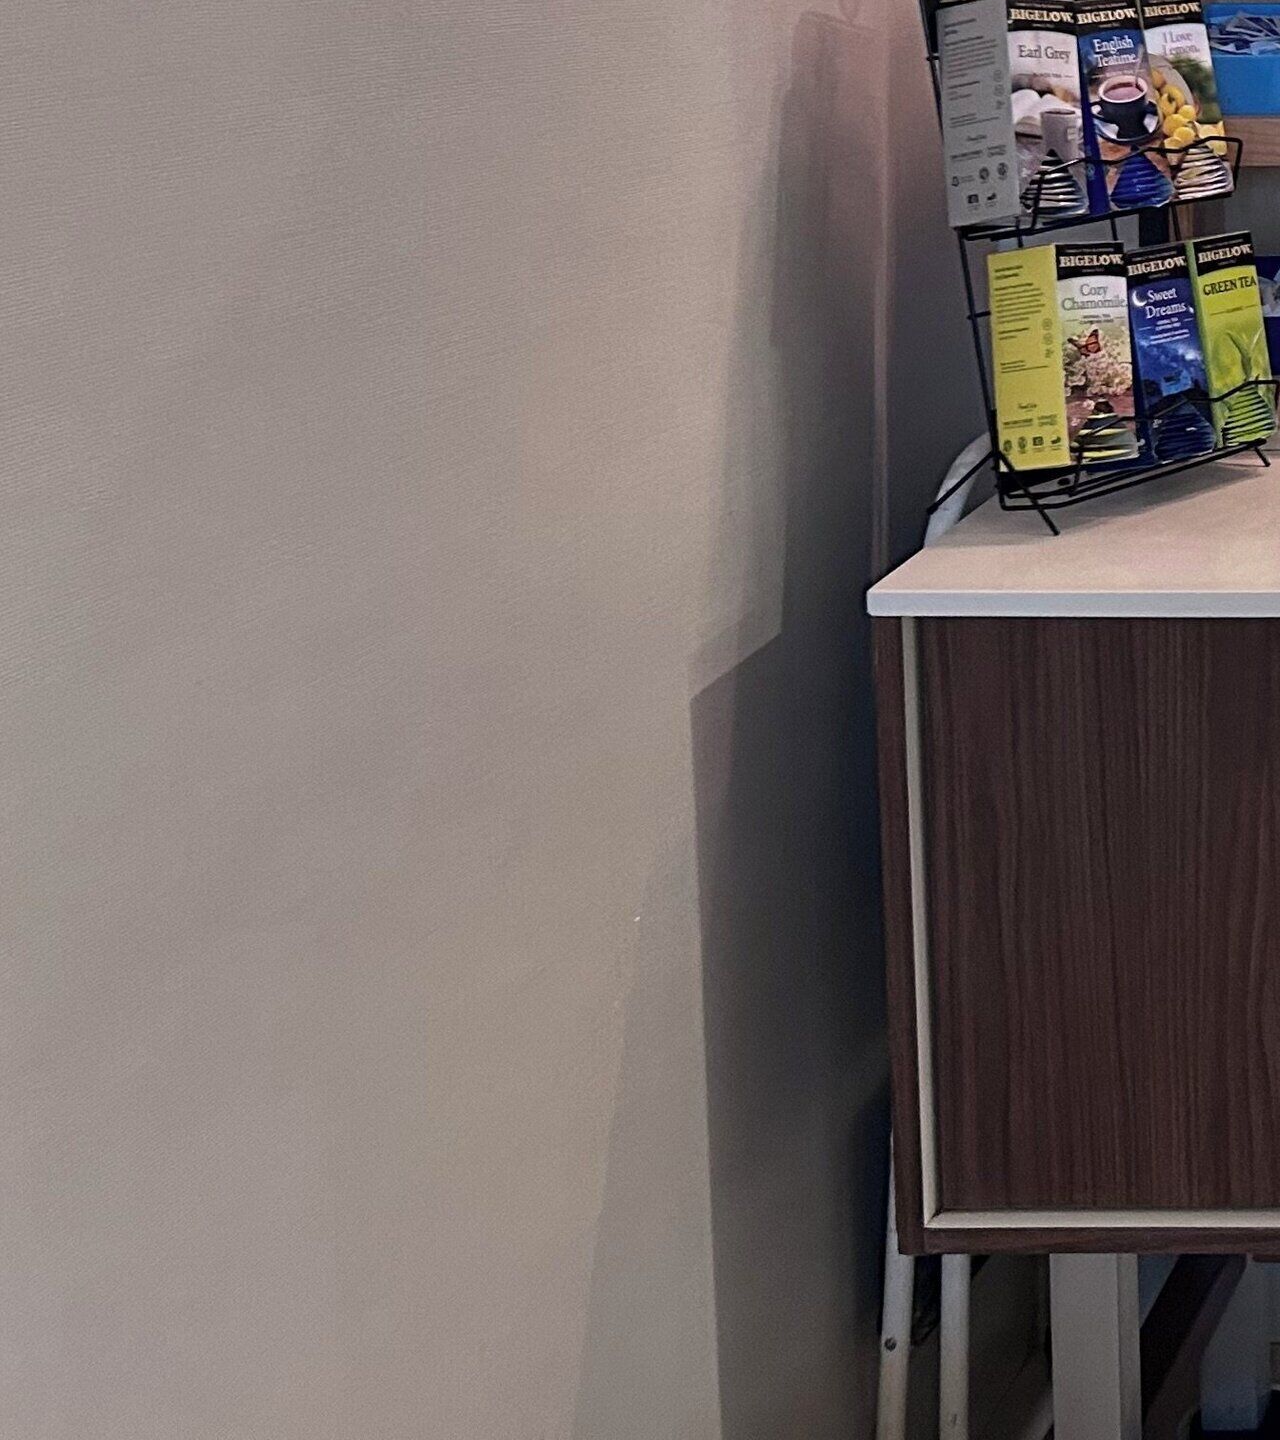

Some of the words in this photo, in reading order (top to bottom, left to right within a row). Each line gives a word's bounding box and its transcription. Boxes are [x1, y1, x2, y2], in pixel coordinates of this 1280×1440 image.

[1010, 9, 1074, 23] BIGELOW
[1077, 8, 1138, 24] BIGELOW
[1143, 2, 1201, 17] BIGELOW
[1093, 35, 1133, 53] English
[1170, 31, 1192, 43] Love
[1019, 44, 1042, 59] Earl
[1045, 46, 1071, 64] Grey
[1097, 52, 1136, 68] Teatime
[1059, 254, 1124, 268] BIGELOW
[1198, 244, 1253, 263] BIGELOW
[1128, 256, 1187, 276] BIGELOW
[1080, 284, 1108, 299] Cozy
[1203, 278, 1237, 296] GREEN
[1238, 276, 1256, 288] TEA
[1147, 288, 1178, 303] Sweet
[1145, 303, 1187, 320] Dreams
